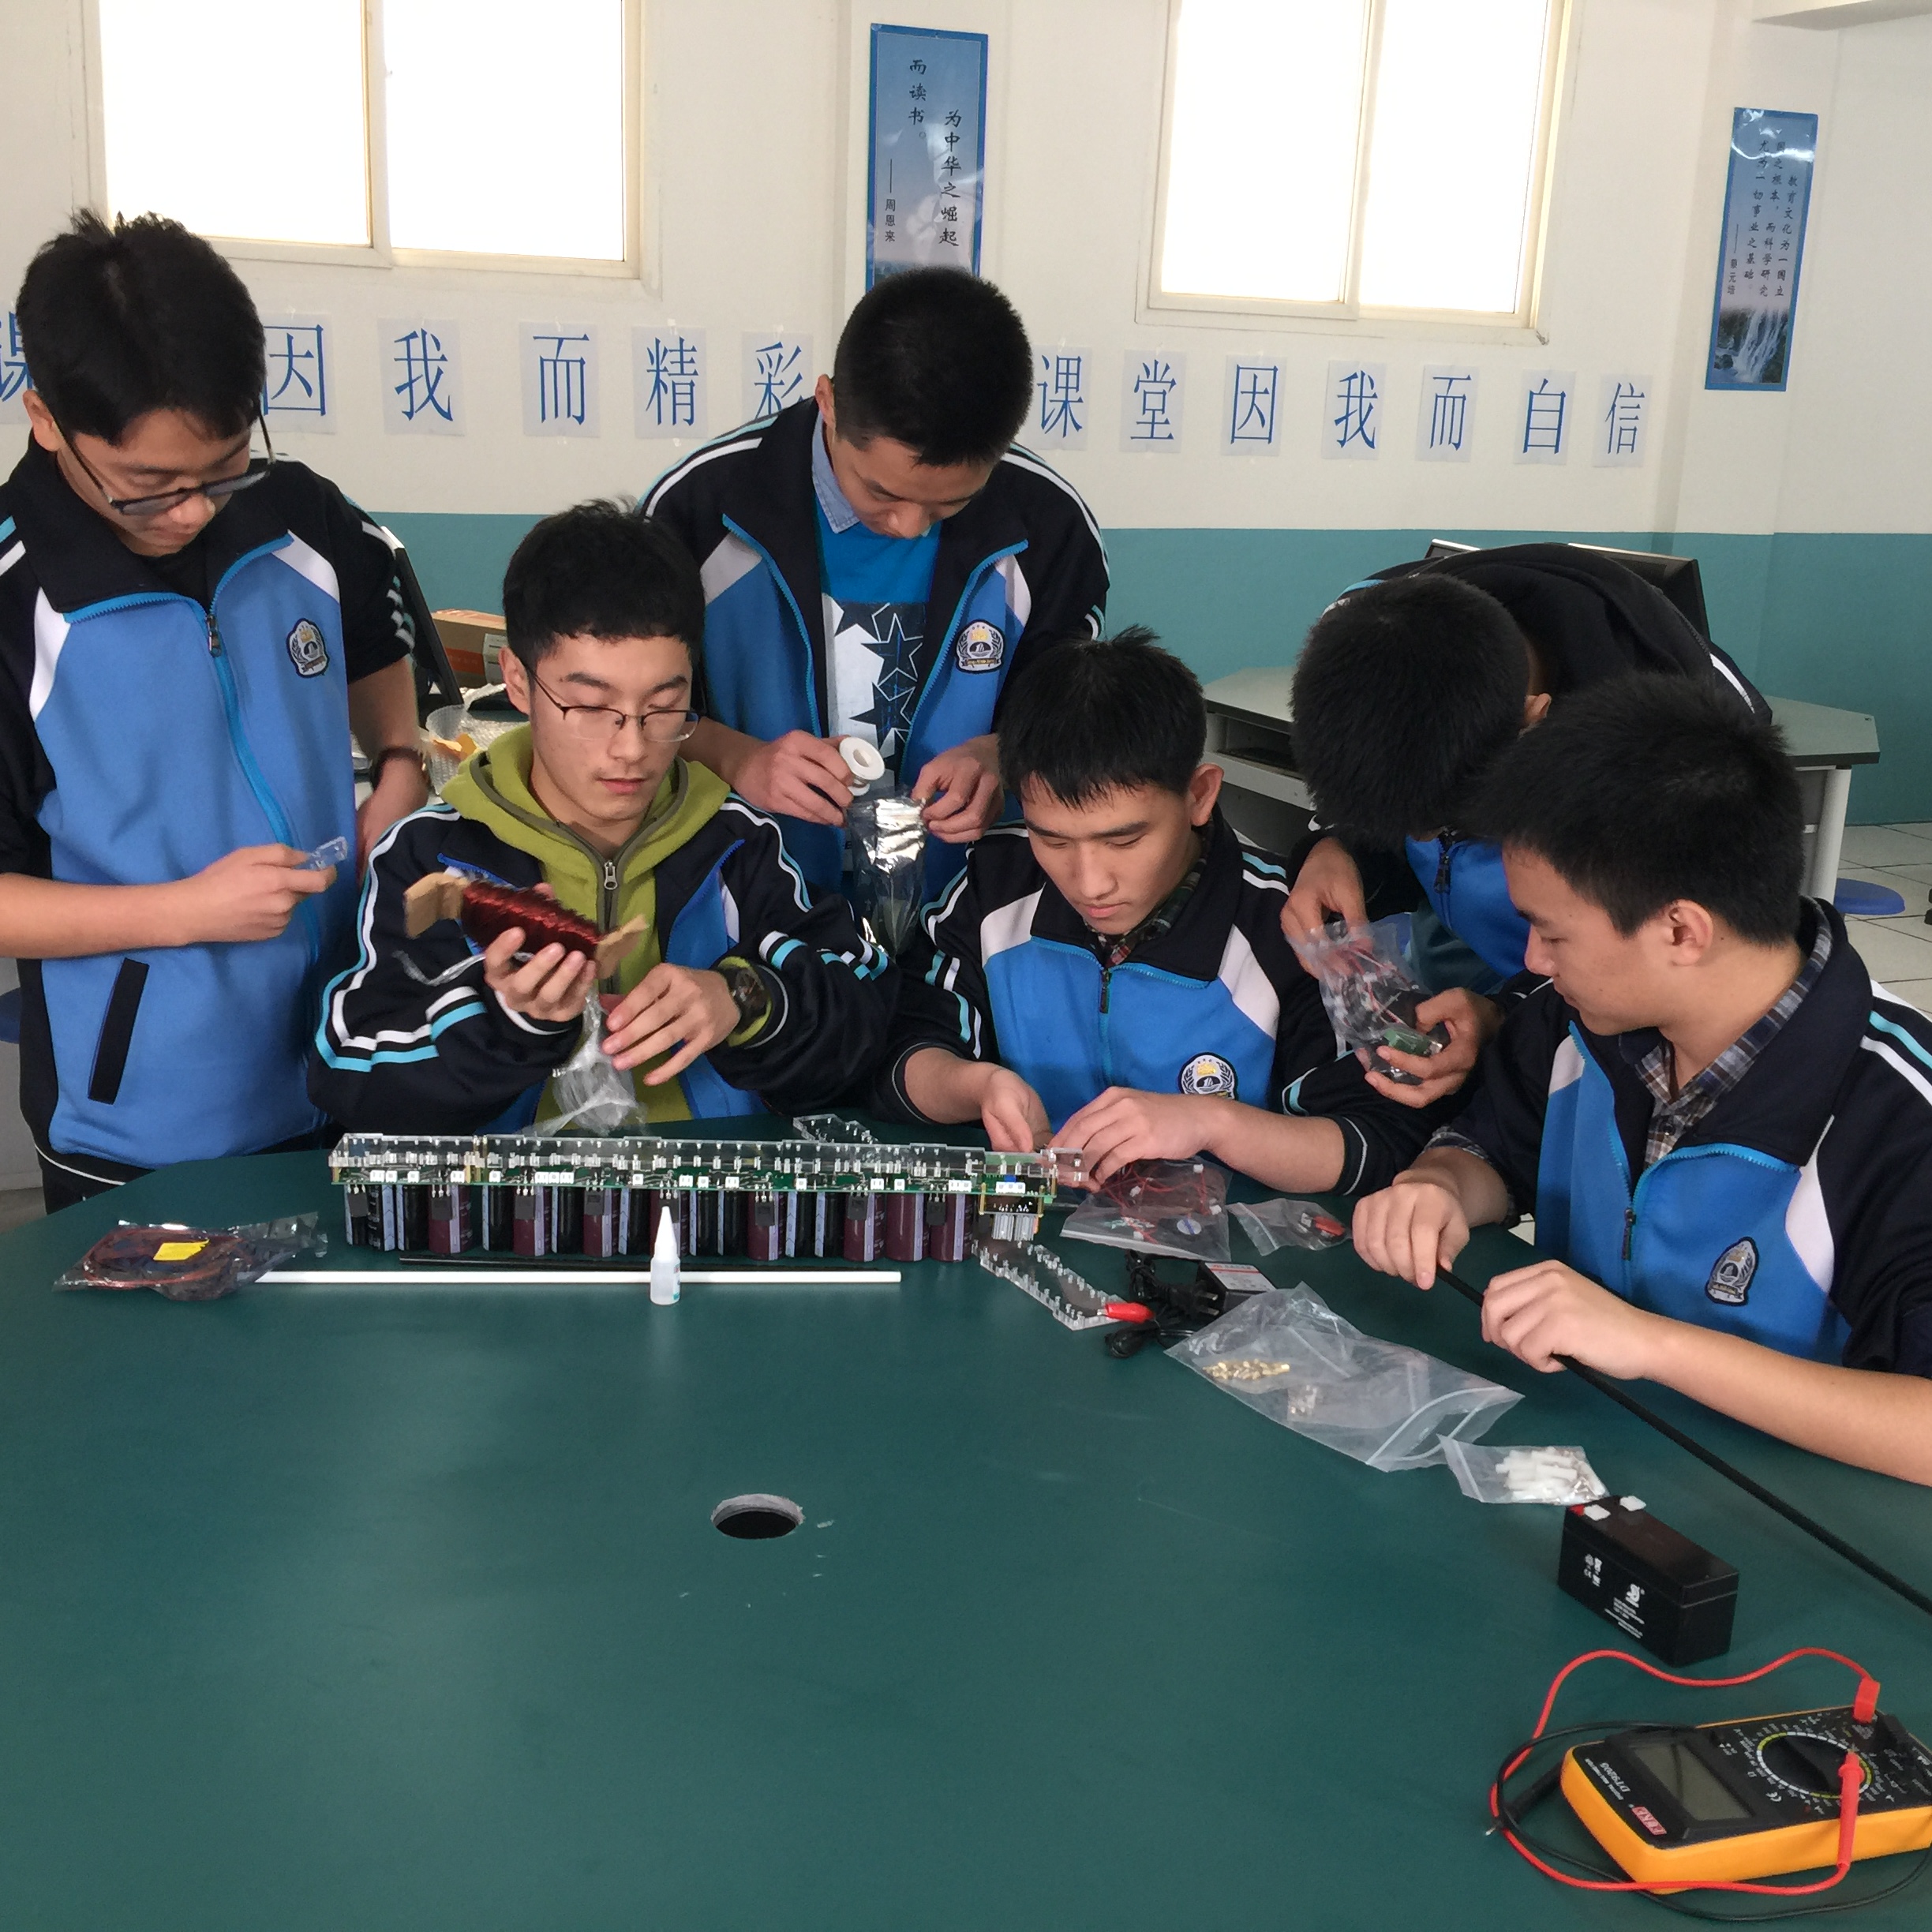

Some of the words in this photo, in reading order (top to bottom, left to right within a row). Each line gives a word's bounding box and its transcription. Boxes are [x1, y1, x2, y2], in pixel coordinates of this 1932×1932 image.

[939, 109, 962, 246] 为中华之崛起
[1037, 354, 1645, 455] 课堂因我而自信
